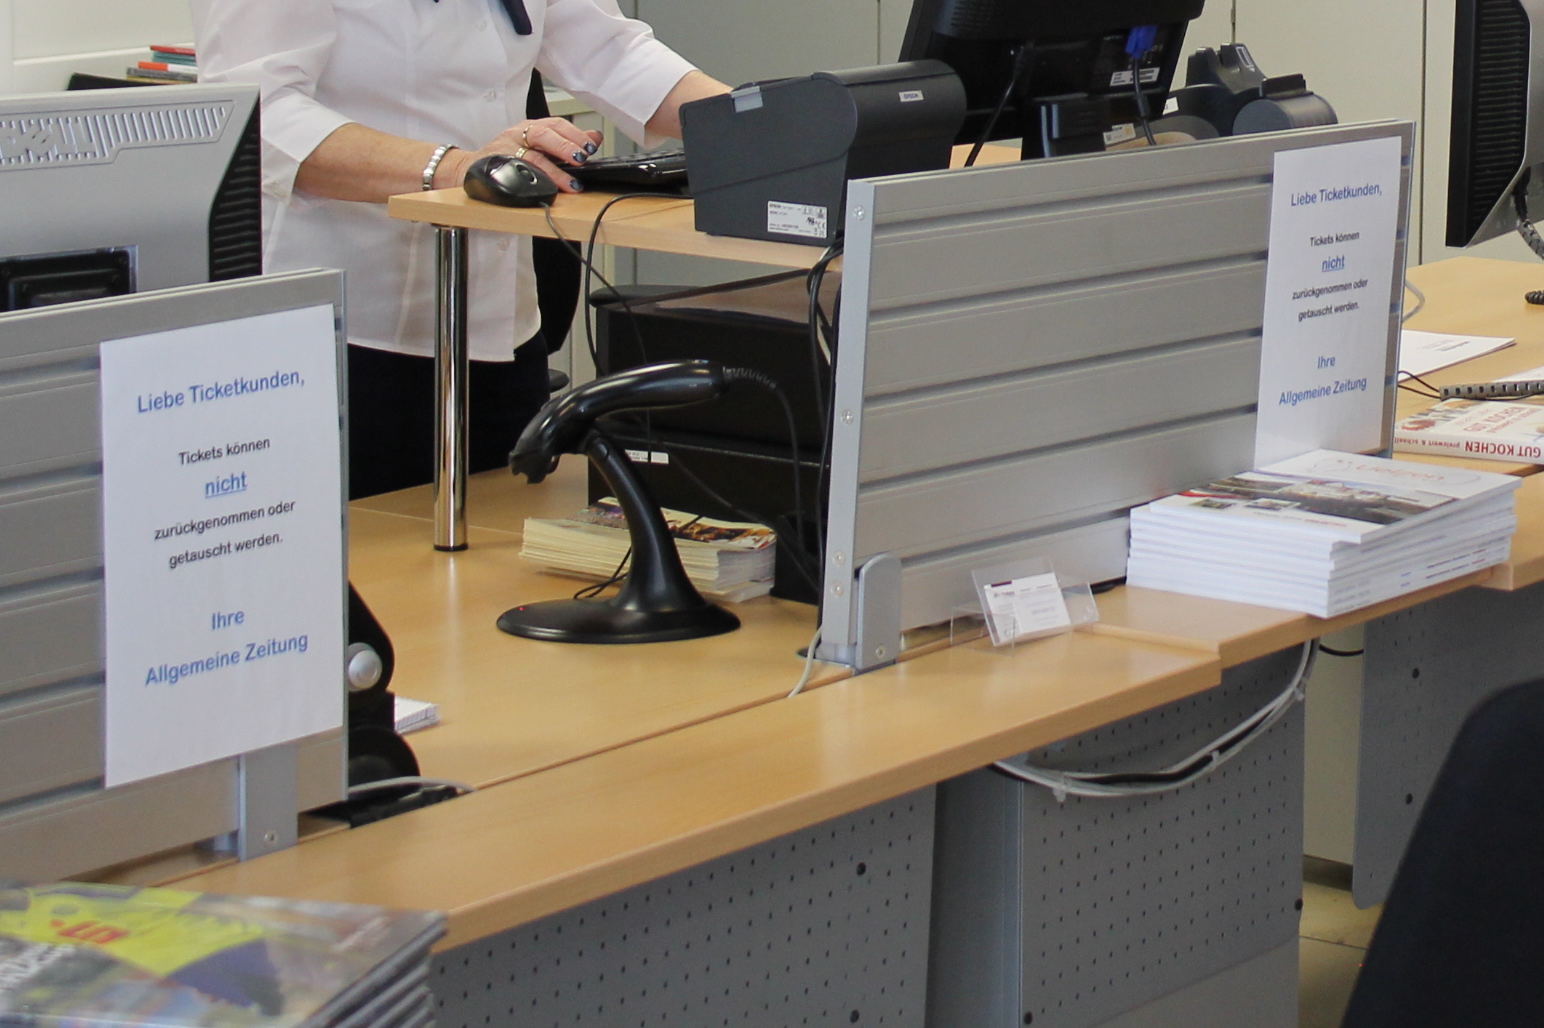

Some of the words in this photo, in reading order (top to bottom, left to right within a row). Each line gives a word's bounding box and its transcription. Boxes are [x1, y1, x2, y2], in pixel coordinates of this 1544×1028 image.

[1290, 189, 1317, 207] Liebe
[1319, 182, 1383, 203] Ticketkunden,
[1309, 235, 1334, 247] Tickets
[1335, 230, 1360, 243] können
[1321, 255, 1345, 271] nicht
[1292, 281, 1353, 300] zurückgenommen
[1353, 278, 1368, 290] oder
[1298, 305, 1333, 322] getauscht
[1334, 301, 1360, 313] werden.
[1317, 355, 1336, 370] Ihre
[137, 388, 185, 413] Liebe
[189, 369, 306, 405] Ticketkunden,
[1279, 383, 1332, 406] Allgemeine
[1333, 376, 1367, 396] Zeitung
[178, 445, 224, 466] Tickets
[226, 437, 271, 456] können
[1394, 436, 1419, 445] schnell
[1428, 439, 1460, 448] preiswert
[1464, 440, 1515, 455] KOCHEN
[1517, 445, 1542, 458] GUT
[204, 470, 248, 498] nicht
[153, 505, 265, 541] zurückgenommen
[267, 499, 296, 519] oder
[168, 541, 232, 569] getauscht
[234, 531, 284, 553] werden.
[210, 608, 245, 631] Ihre
[145, 648, 241, 687] Allgemeine
[244, 633, 309, 663] Zeitung
